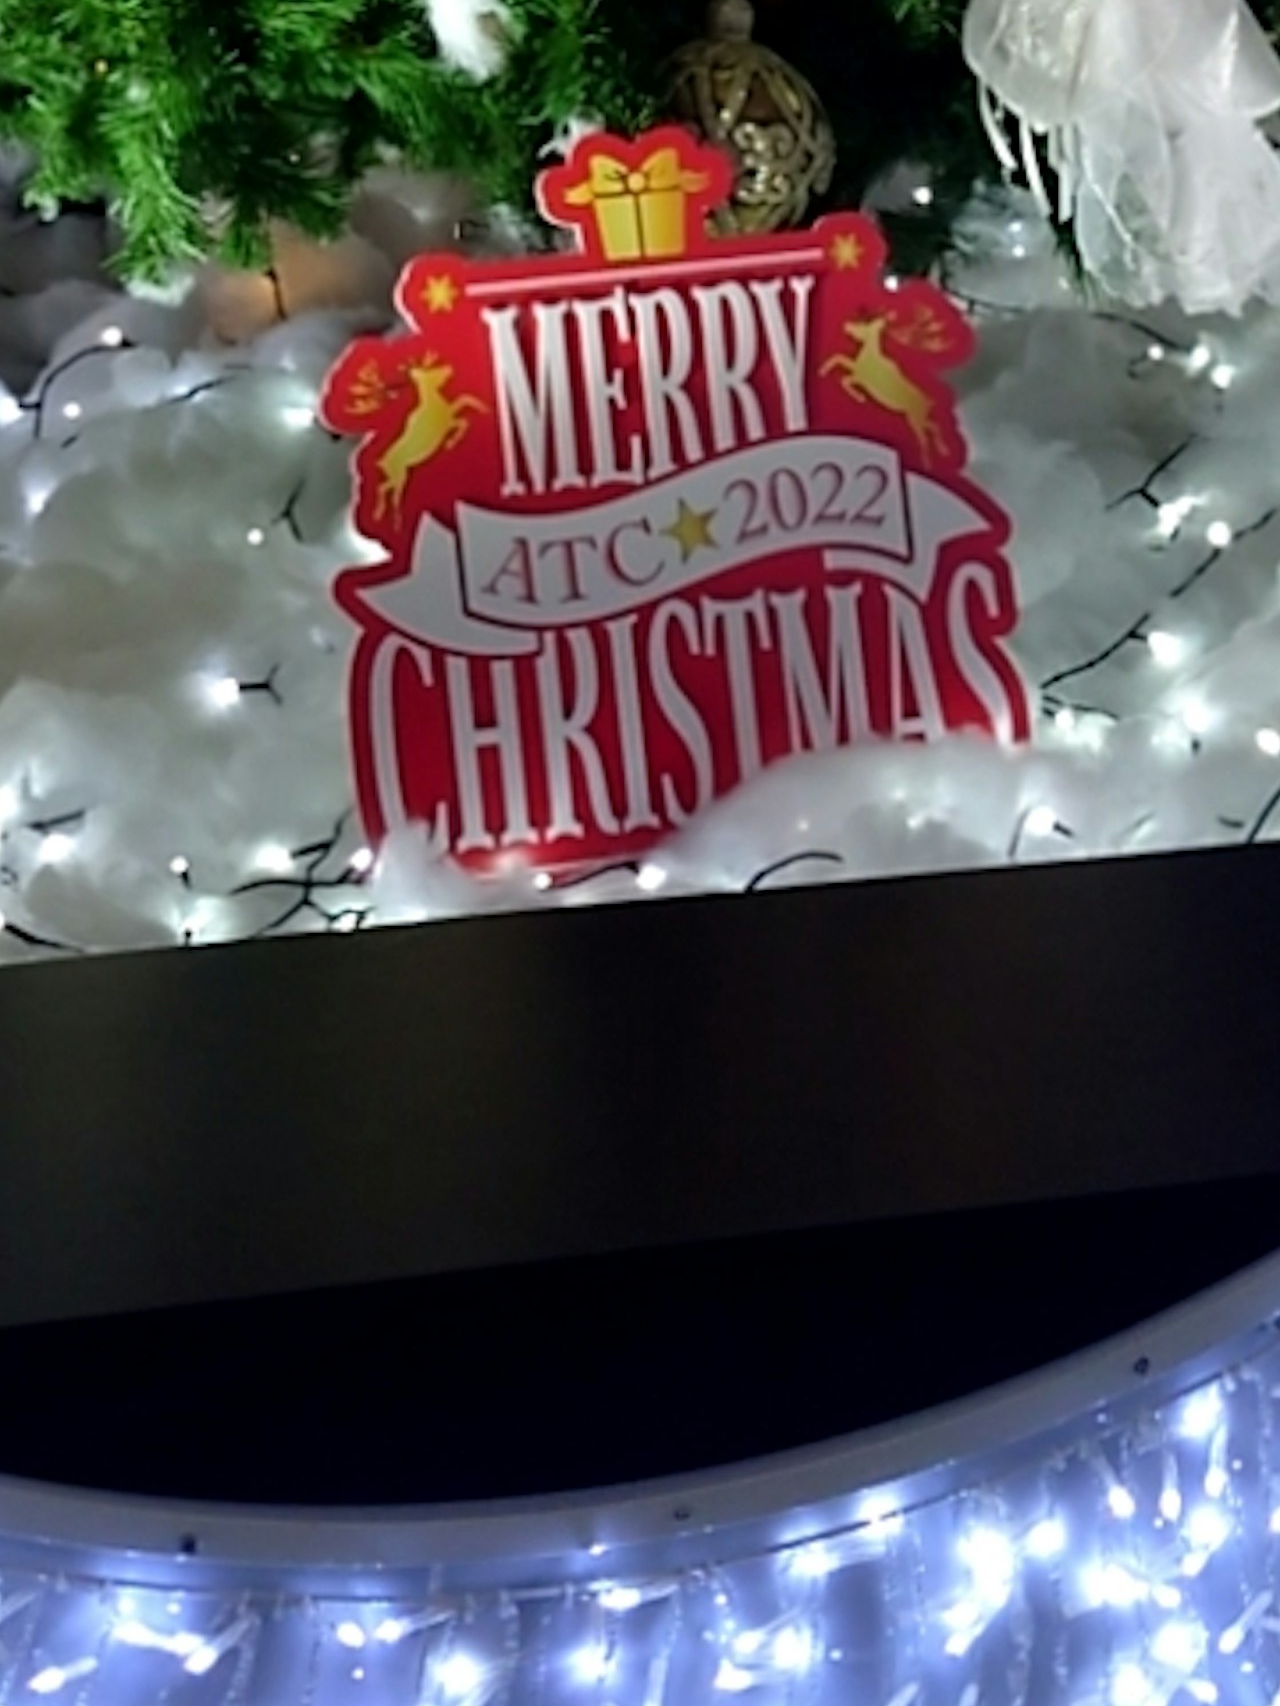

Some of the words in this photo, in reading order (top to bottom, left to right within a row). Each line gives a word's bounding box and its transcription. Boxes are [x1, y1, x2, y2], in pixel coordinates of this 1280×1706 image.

[481, 275, 816, 497] MERRY
[481, 513, 670, 605] ATC
[723, 461, 891, 547] 2022
[371, 561, 1025, 852] CHRISTMAS
